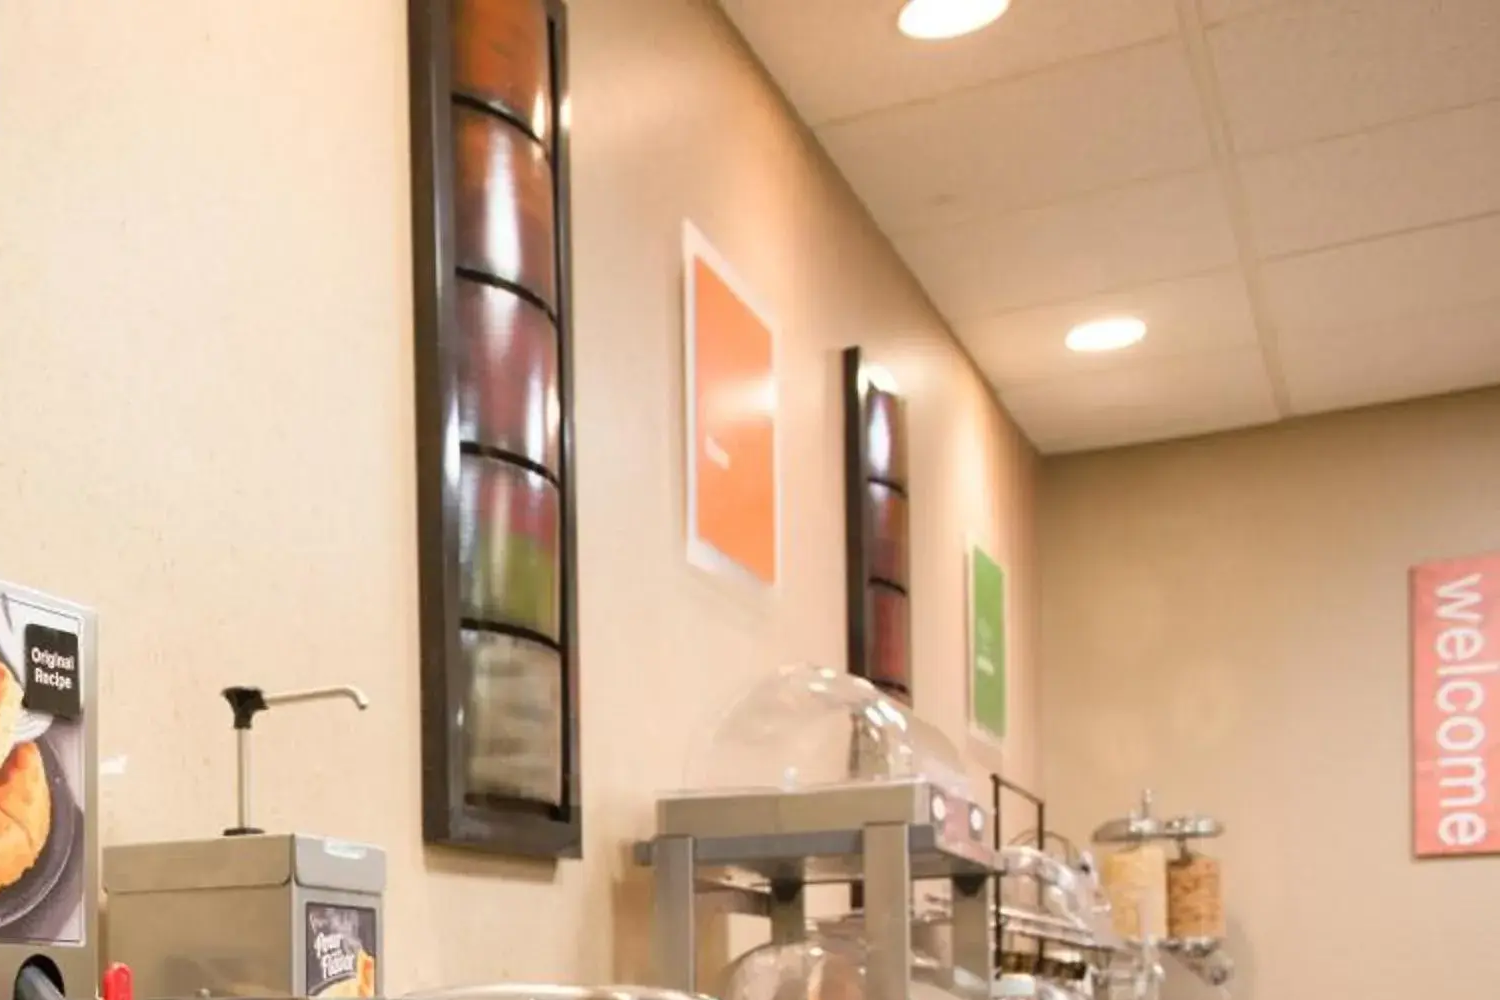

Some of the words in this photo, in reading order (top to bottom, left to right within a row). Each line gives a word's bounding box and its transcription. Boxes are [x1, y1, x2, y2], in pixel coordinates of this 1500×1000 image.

[31, 646, 75, 671] Original
[35, 667, 73, 690] Recipe
[1435, 573, 1500, 848] welcome
